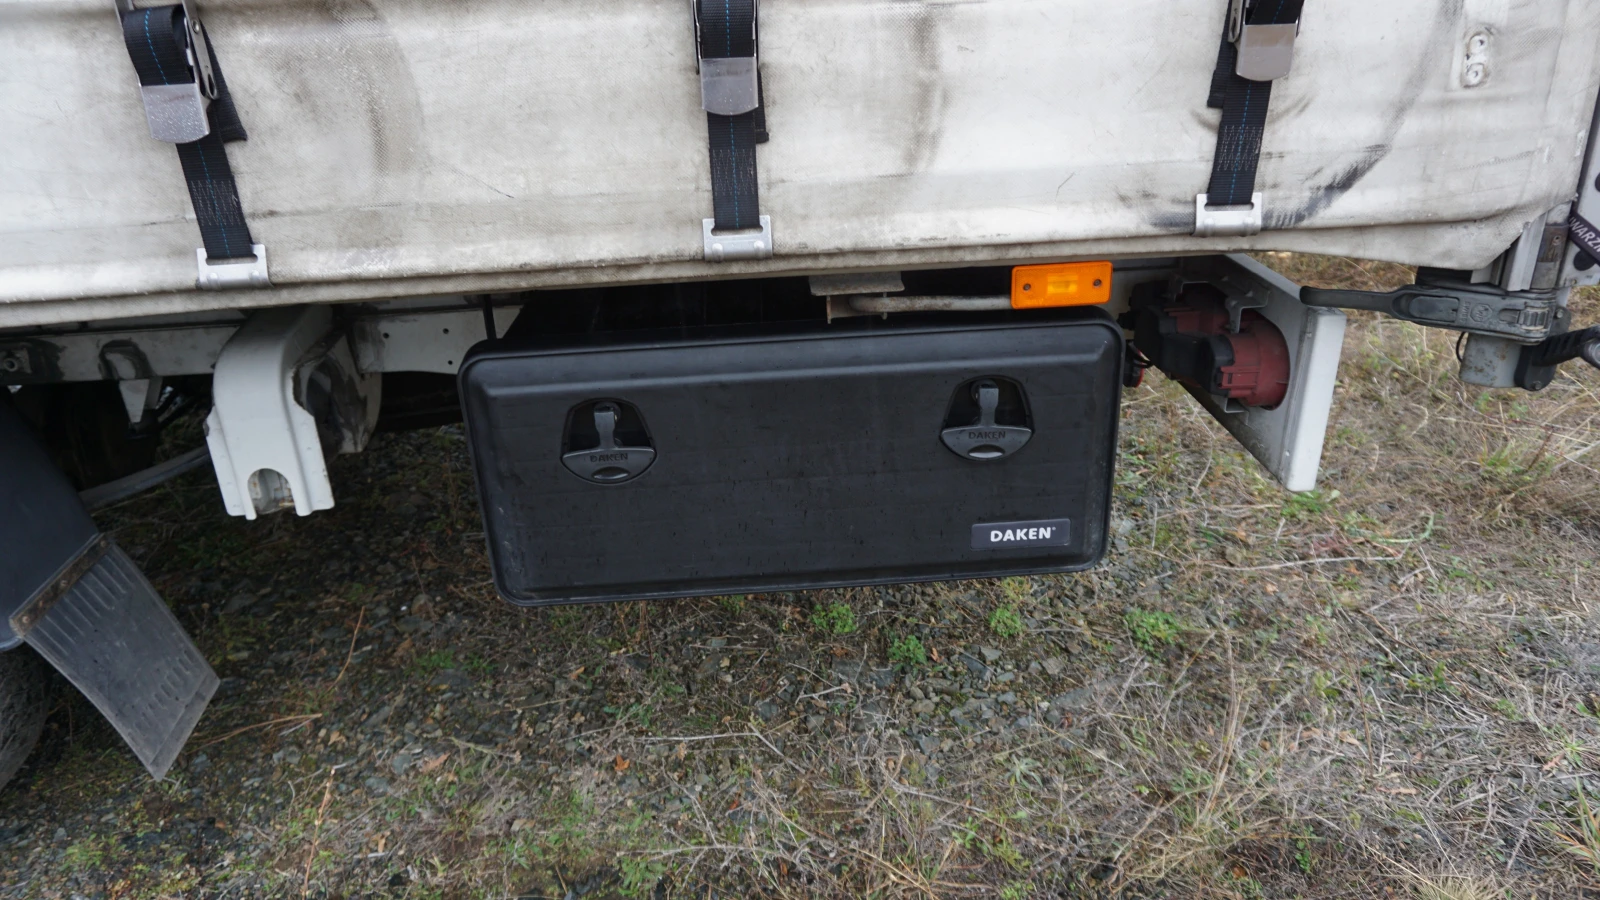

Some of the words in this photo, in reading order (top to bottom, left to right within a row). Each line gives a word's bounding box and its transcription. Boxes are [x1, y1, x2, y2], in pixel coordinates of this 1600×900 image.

[968, 430, 1006, 440] DAKEN
[589, 452, 628, 463] DAKEN
[990, 526, 1052, 542] DAKEN
